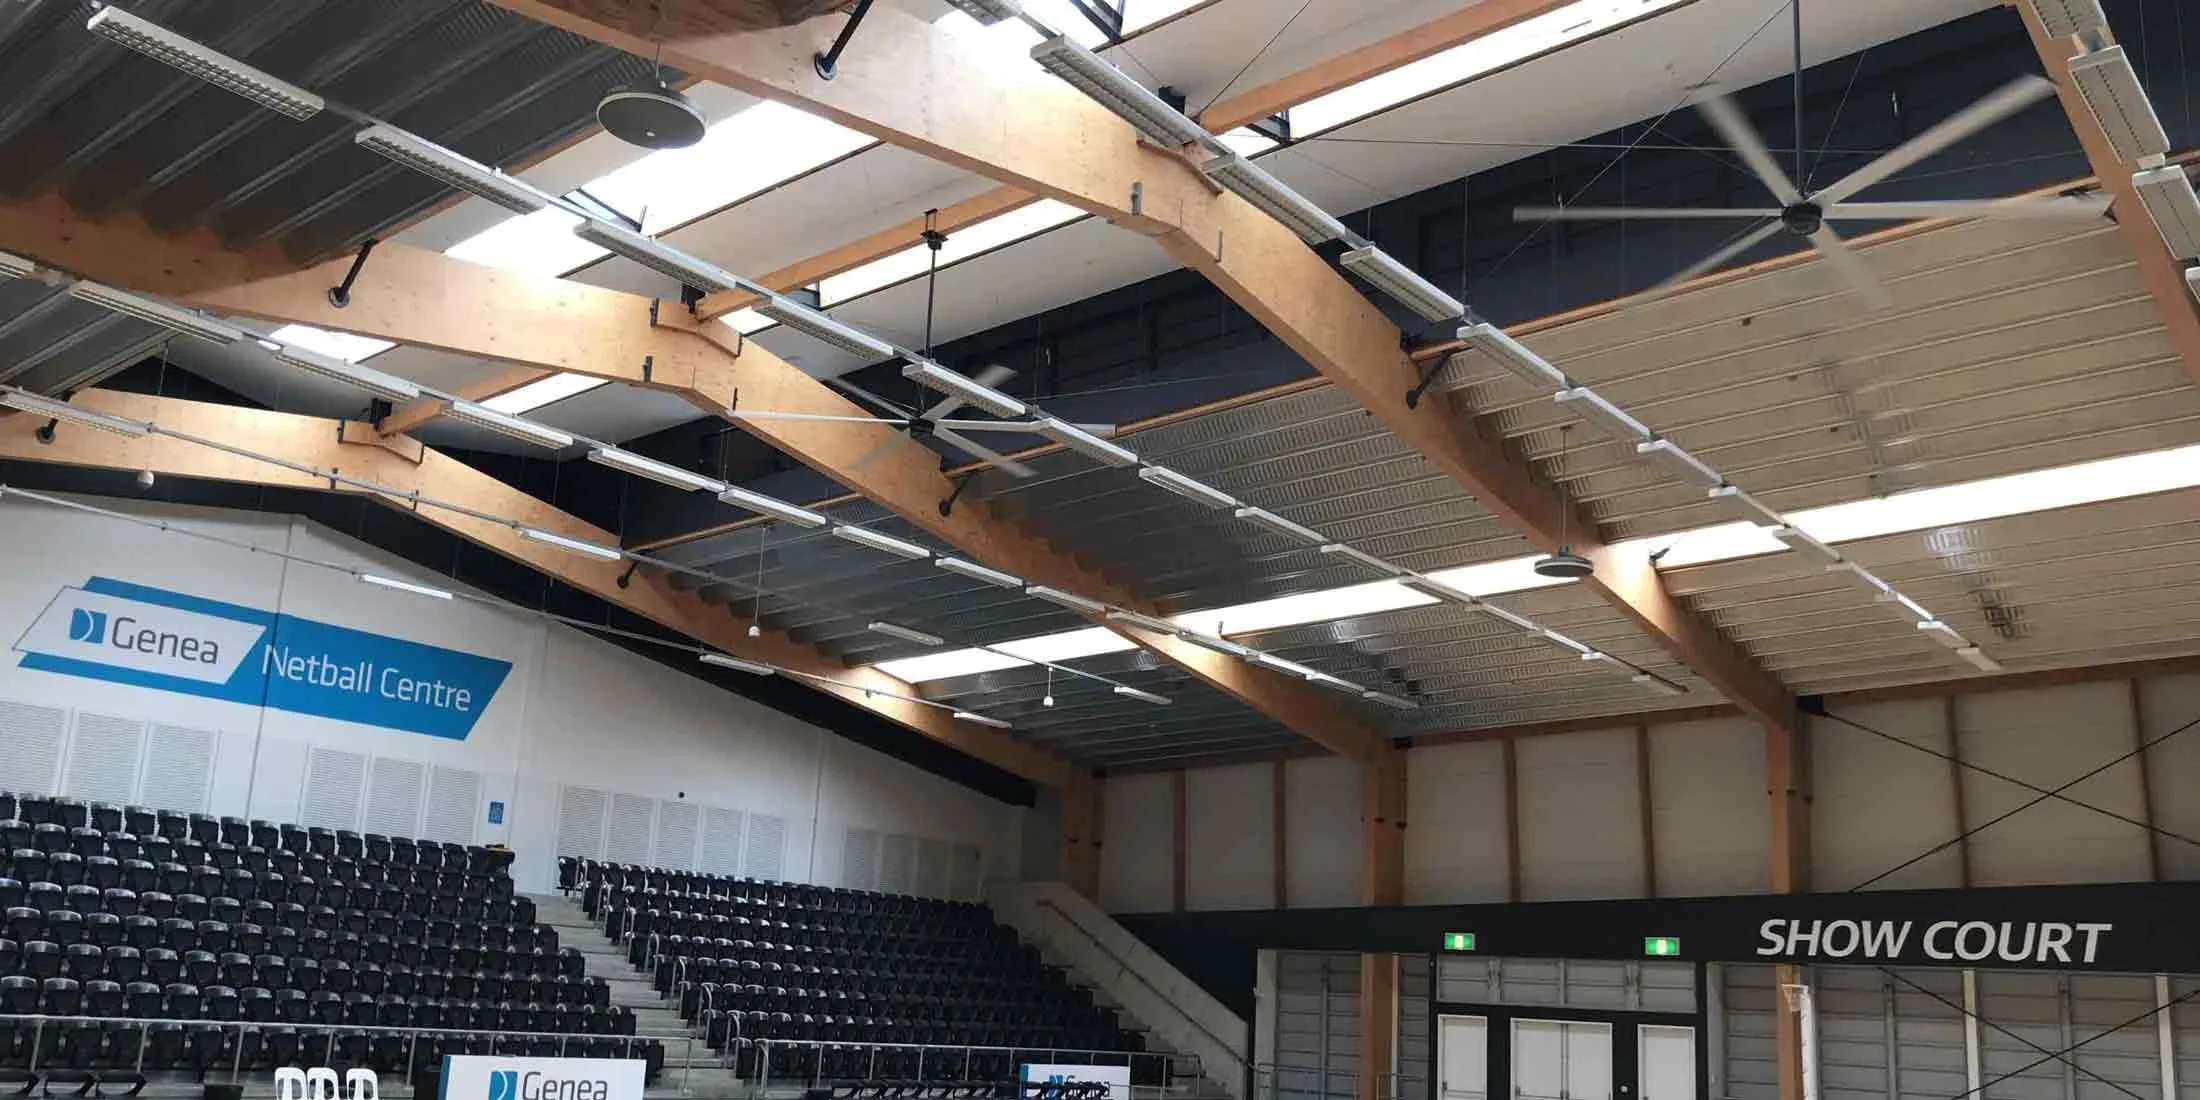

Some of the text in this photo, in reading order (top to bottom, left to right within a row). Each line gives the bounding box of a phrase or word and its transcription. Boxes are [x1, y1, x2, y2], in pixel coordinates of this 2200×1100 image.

[112, 617, 471, 712] Genea Netball Centre
[1756, 919, 2113, 963] SHOW COURT
[522, 1071, 608, 1100] Genea
